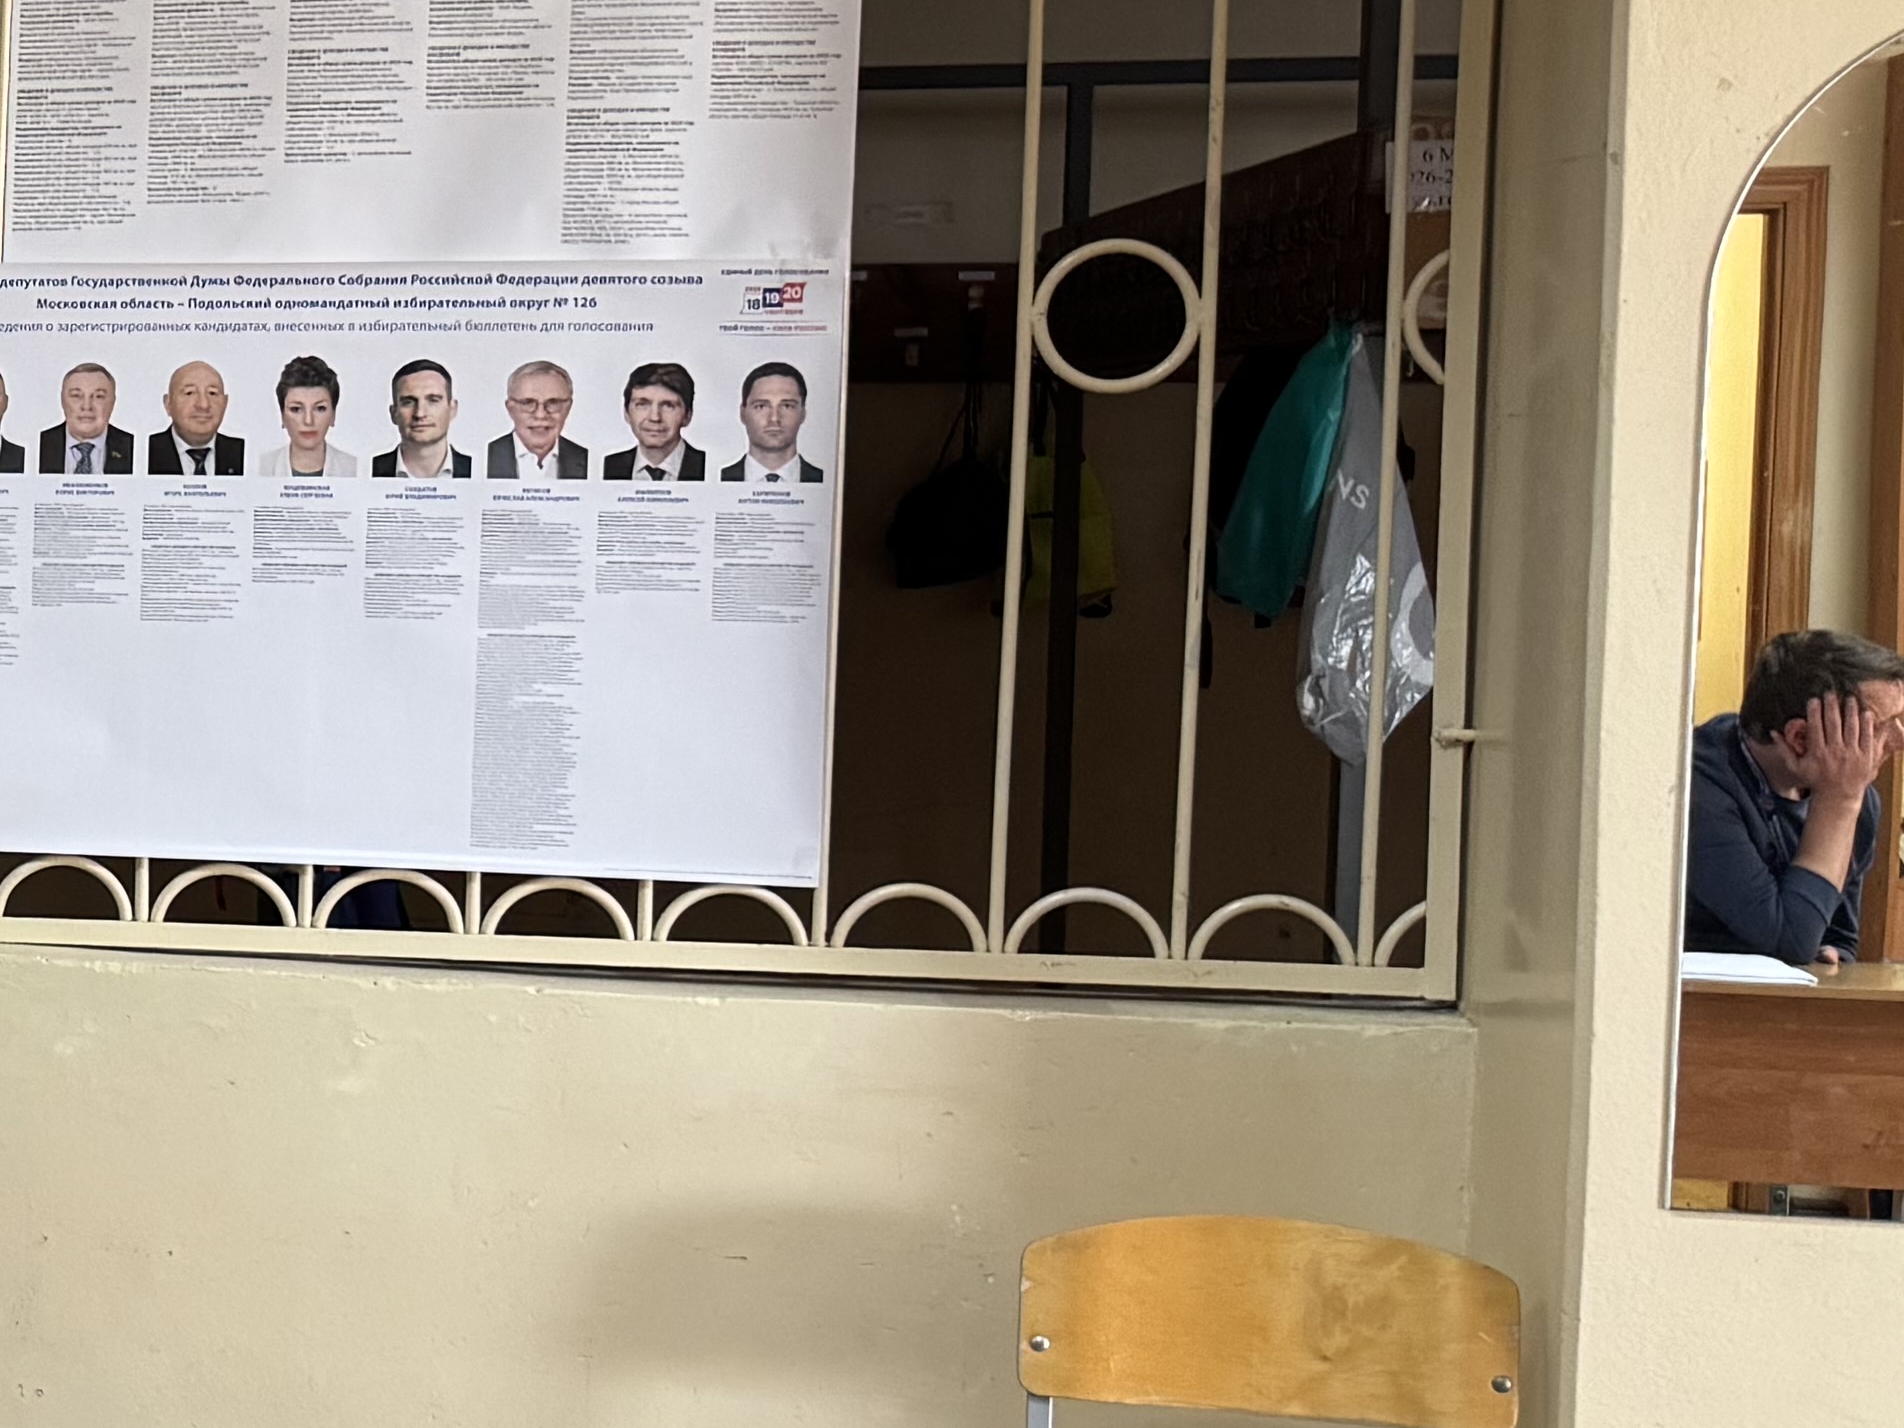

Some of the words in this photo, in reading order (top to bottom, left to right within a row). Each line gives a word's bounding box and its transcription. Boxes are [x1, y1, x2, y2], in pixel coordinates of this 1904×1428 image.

[70, 275, 187, 290] Государственной
[189, 275, 230, 289] Думы
[233, 274, 335, 289] Федерального
[337, 274, 407, 289] Собрания
[410, 274, 493, 286] Российской
[495, 273, 578, 288] Федерации
[580, 275, 647, 287] девятого
[650, 275, 703, 285] созыва
[36, 297, 117, 310] Московская
[120, 297, 174, 310] область
[187, 297, 272, 311] Подольский
[274, 297, 390, 311] одномандатный
[393, 296, 506, 311] избирательный
[509, 298, 550, 311] округ
[746, 297, 760, 310] 18
[764, 292, 779, 304] 19
[783, 286, 801, 299] 20
[56, 323, 191, 335] зарегистрированных
[273, 323, 344, 333] внесенных
[358, 320, 461, 335] избирательный
[539, 323, 564, 334] для
[567, 323, 654, 333] голосования
